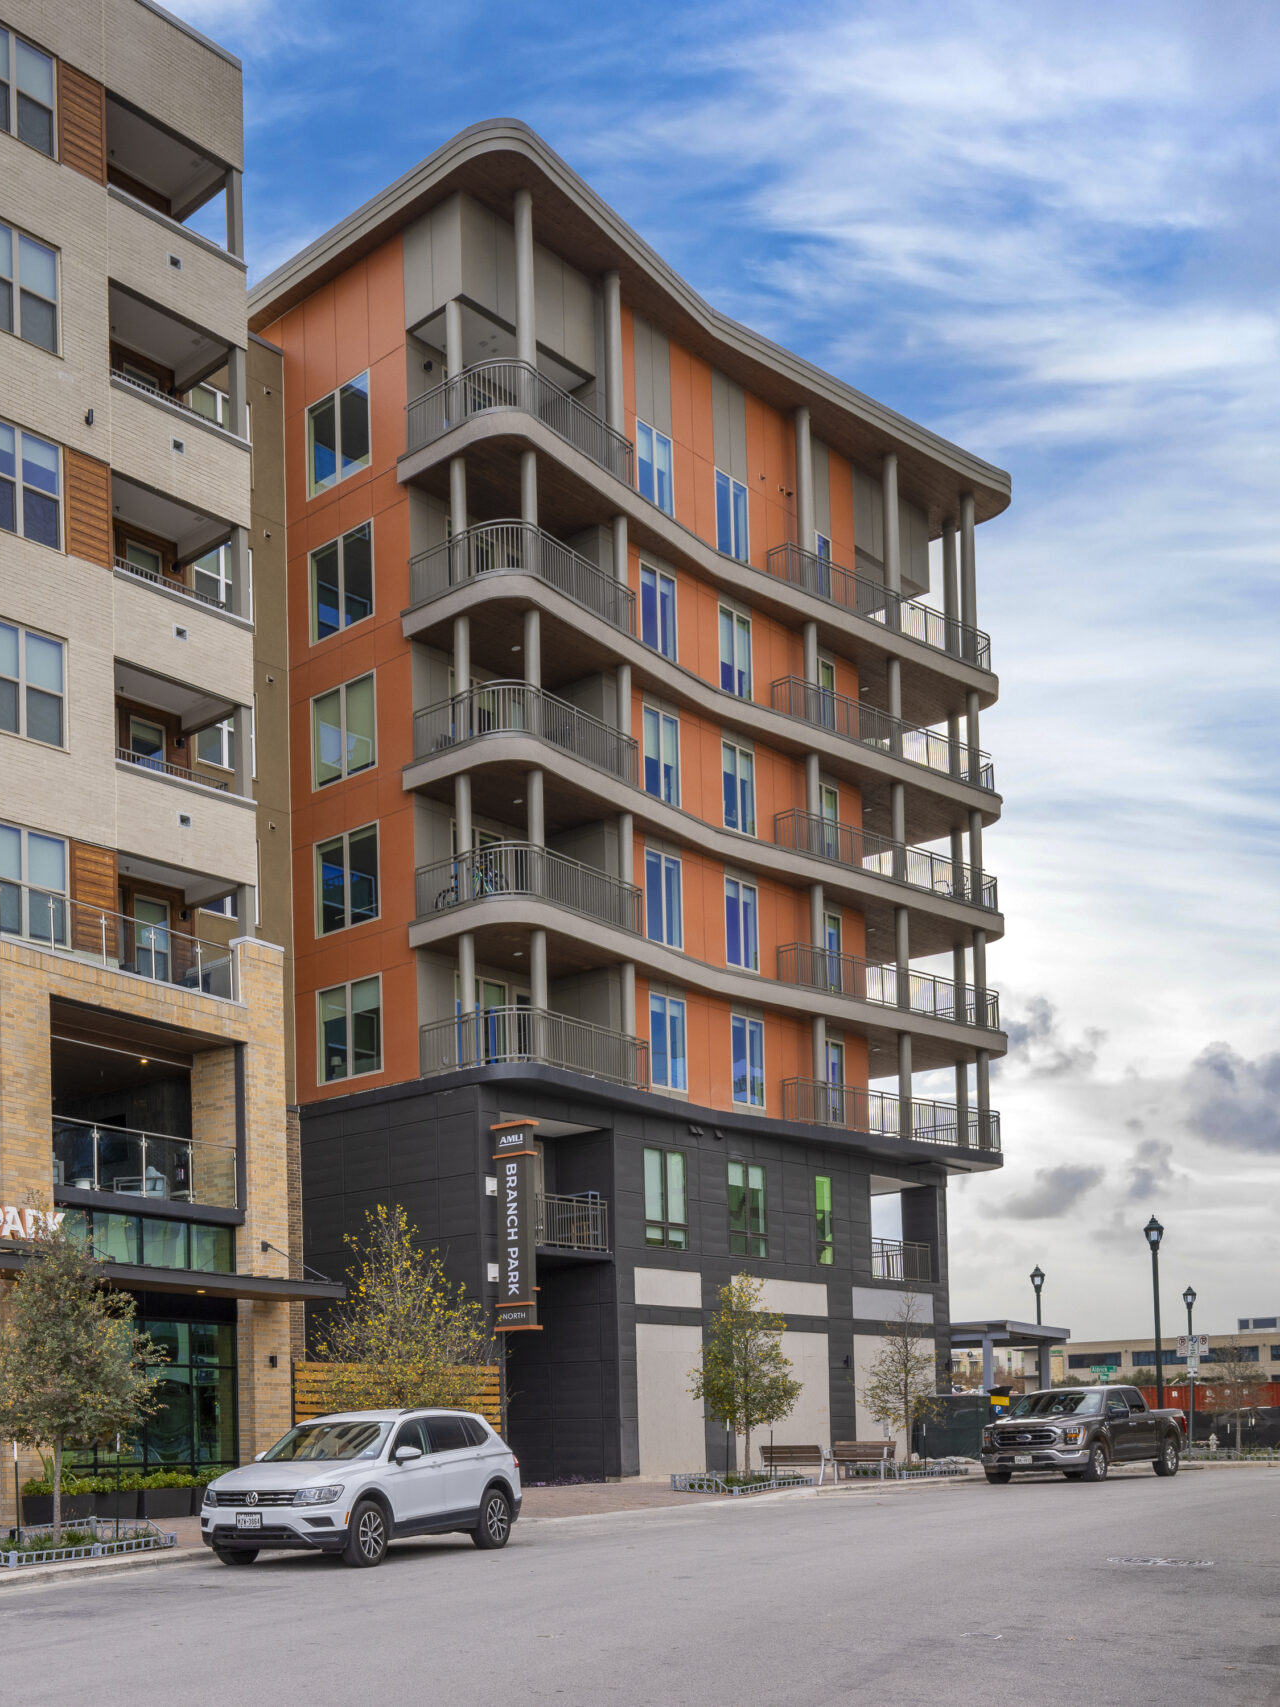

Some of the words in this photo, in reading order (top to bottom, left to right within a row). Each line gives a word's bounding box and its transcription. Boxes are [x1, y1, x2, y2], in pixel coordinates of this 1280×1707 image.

[500, 1133, 523, 1144] AMLI
[506, 1163, 518, 1240] BRANCH
[507, 1247, 519, 1296] PARK
[502, 1312, 526, 1320] NORTH
